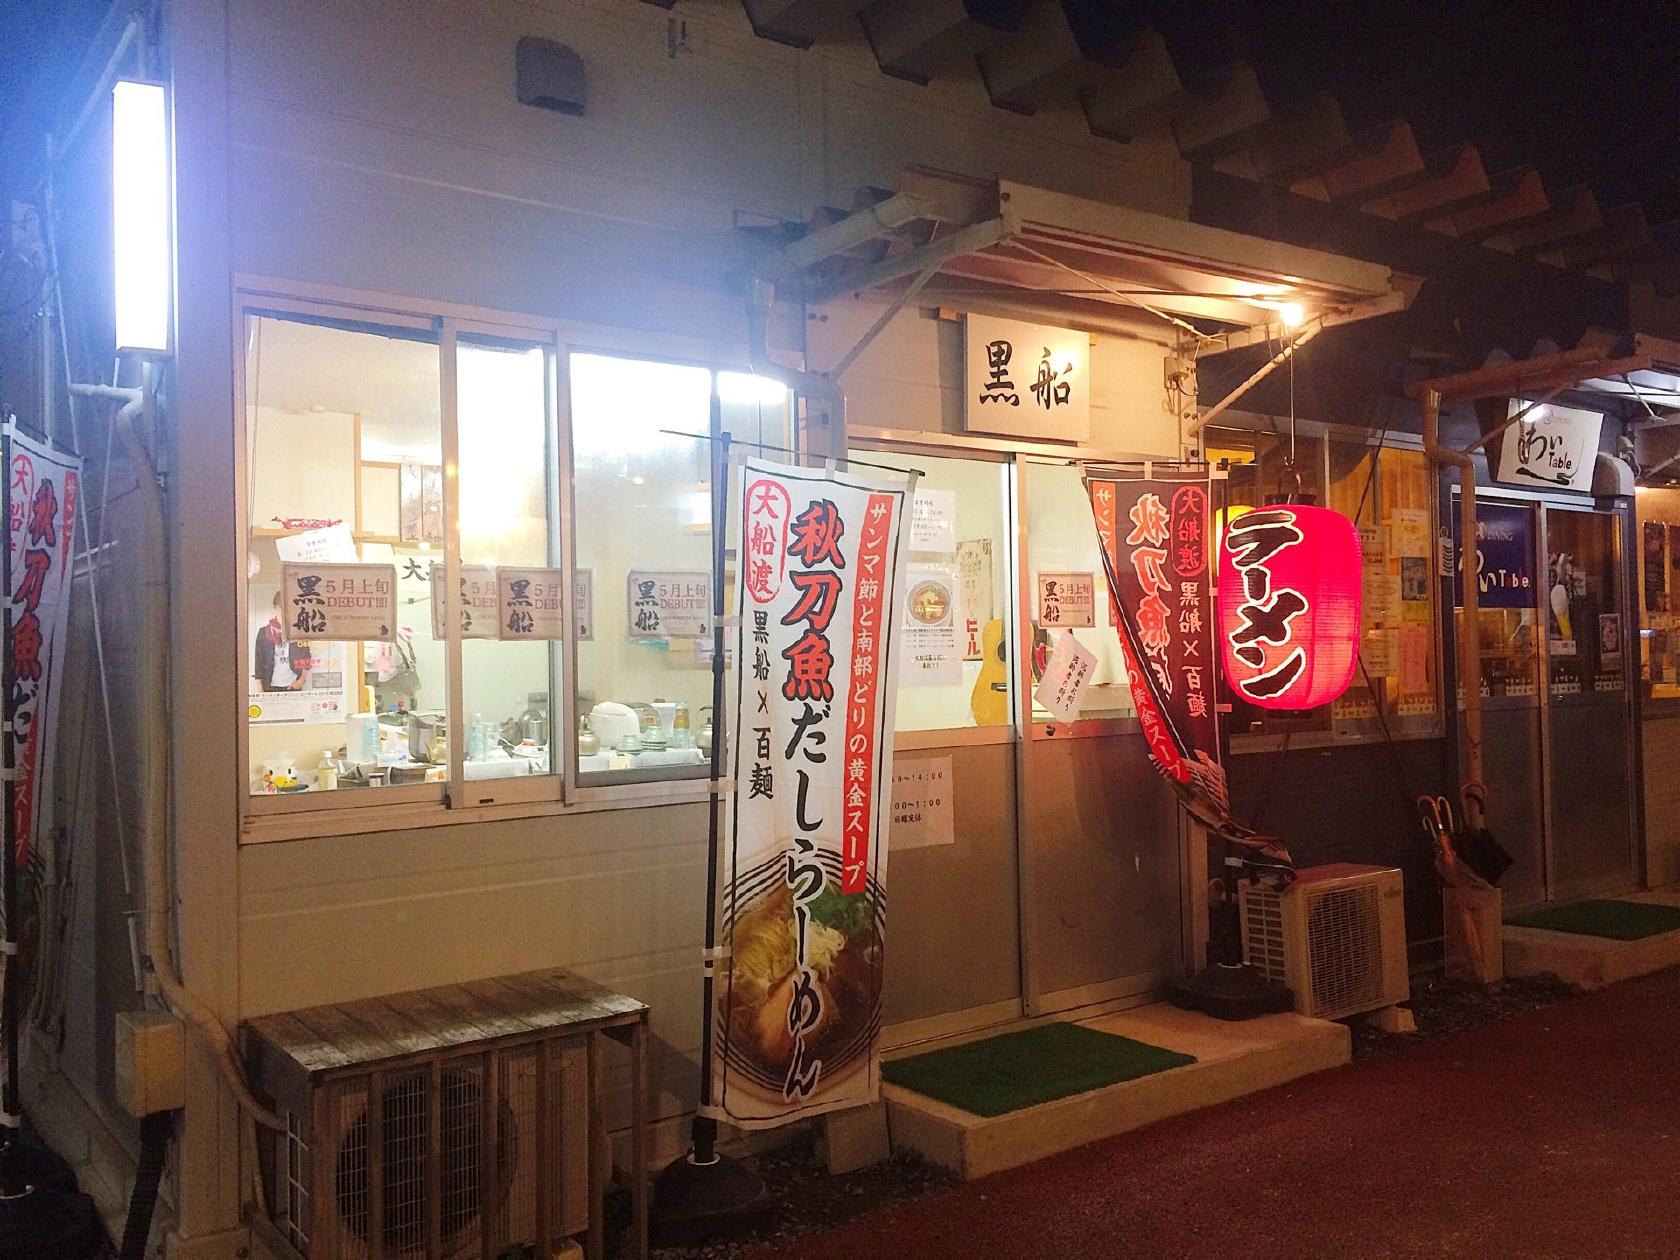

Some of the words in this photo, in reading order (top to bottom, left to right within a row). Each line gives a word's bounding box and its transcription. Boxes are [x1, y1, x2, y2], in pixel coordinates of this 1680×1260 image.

[979, 340, 1073, 410] 黒船
[751, 484, 780, 595] 大船渡
[293, 575, 327, 633] 黒船
[326, 579, 389, 595] 5月上旬
[507, 579, 534, 633] 黒船
[635, 580, 660, 631] 黒船
[660, 584, 706, 598] 5月上旬
[1043, 581, 1060, 622] 黒船
[1227, 510, 1309, 699] ラーメン
[844, 501, 888, 886] サンマ節と南部どりの黄金スープ
[780, 498, 846, 1098] 秋刀魚だしらーめん
